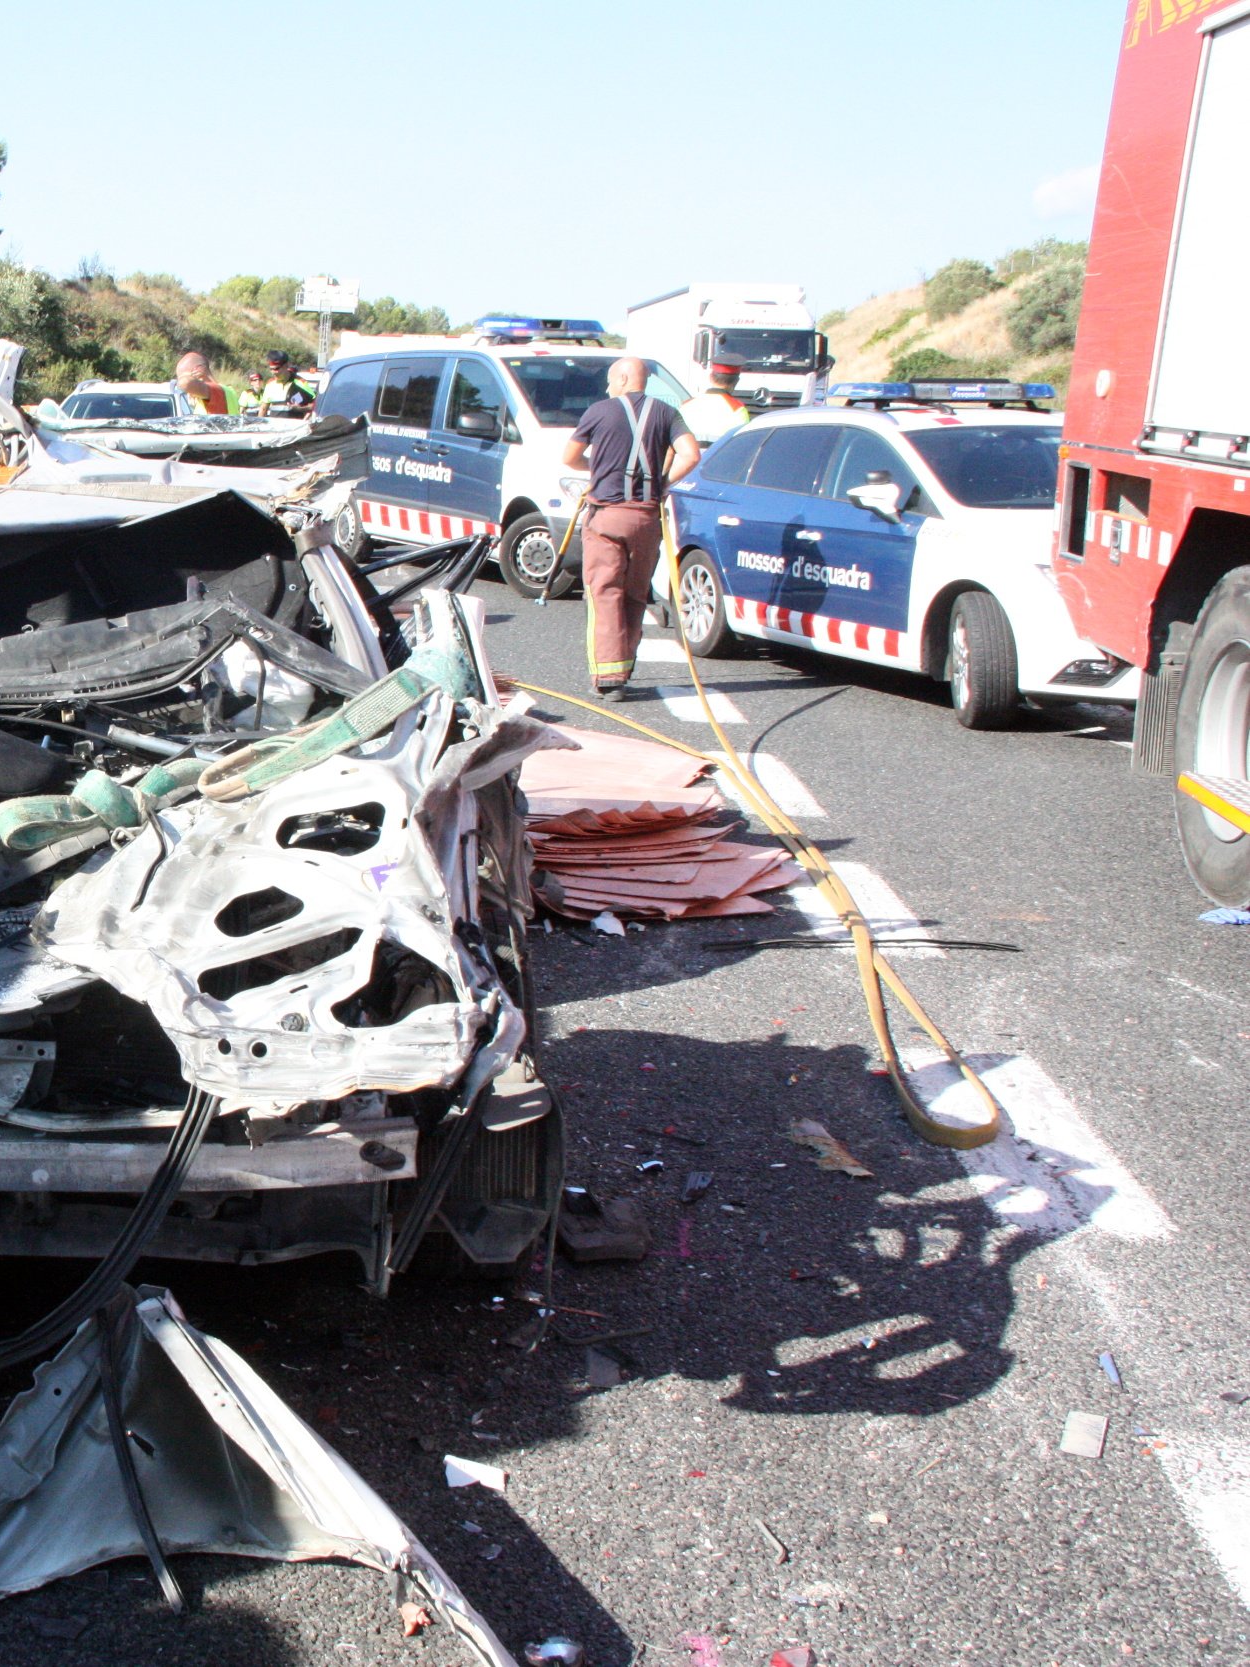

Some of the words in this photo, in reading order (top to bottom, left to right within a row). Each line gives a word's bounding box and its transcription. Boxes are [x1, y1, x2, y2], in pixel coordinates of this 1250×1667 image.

[371, 456, 391, 473] sos
[395, 455, 452, 483] d'esquadra
[737, 550, 785, 575] mossos
[792, 555, 871, 590] d'esquadra
